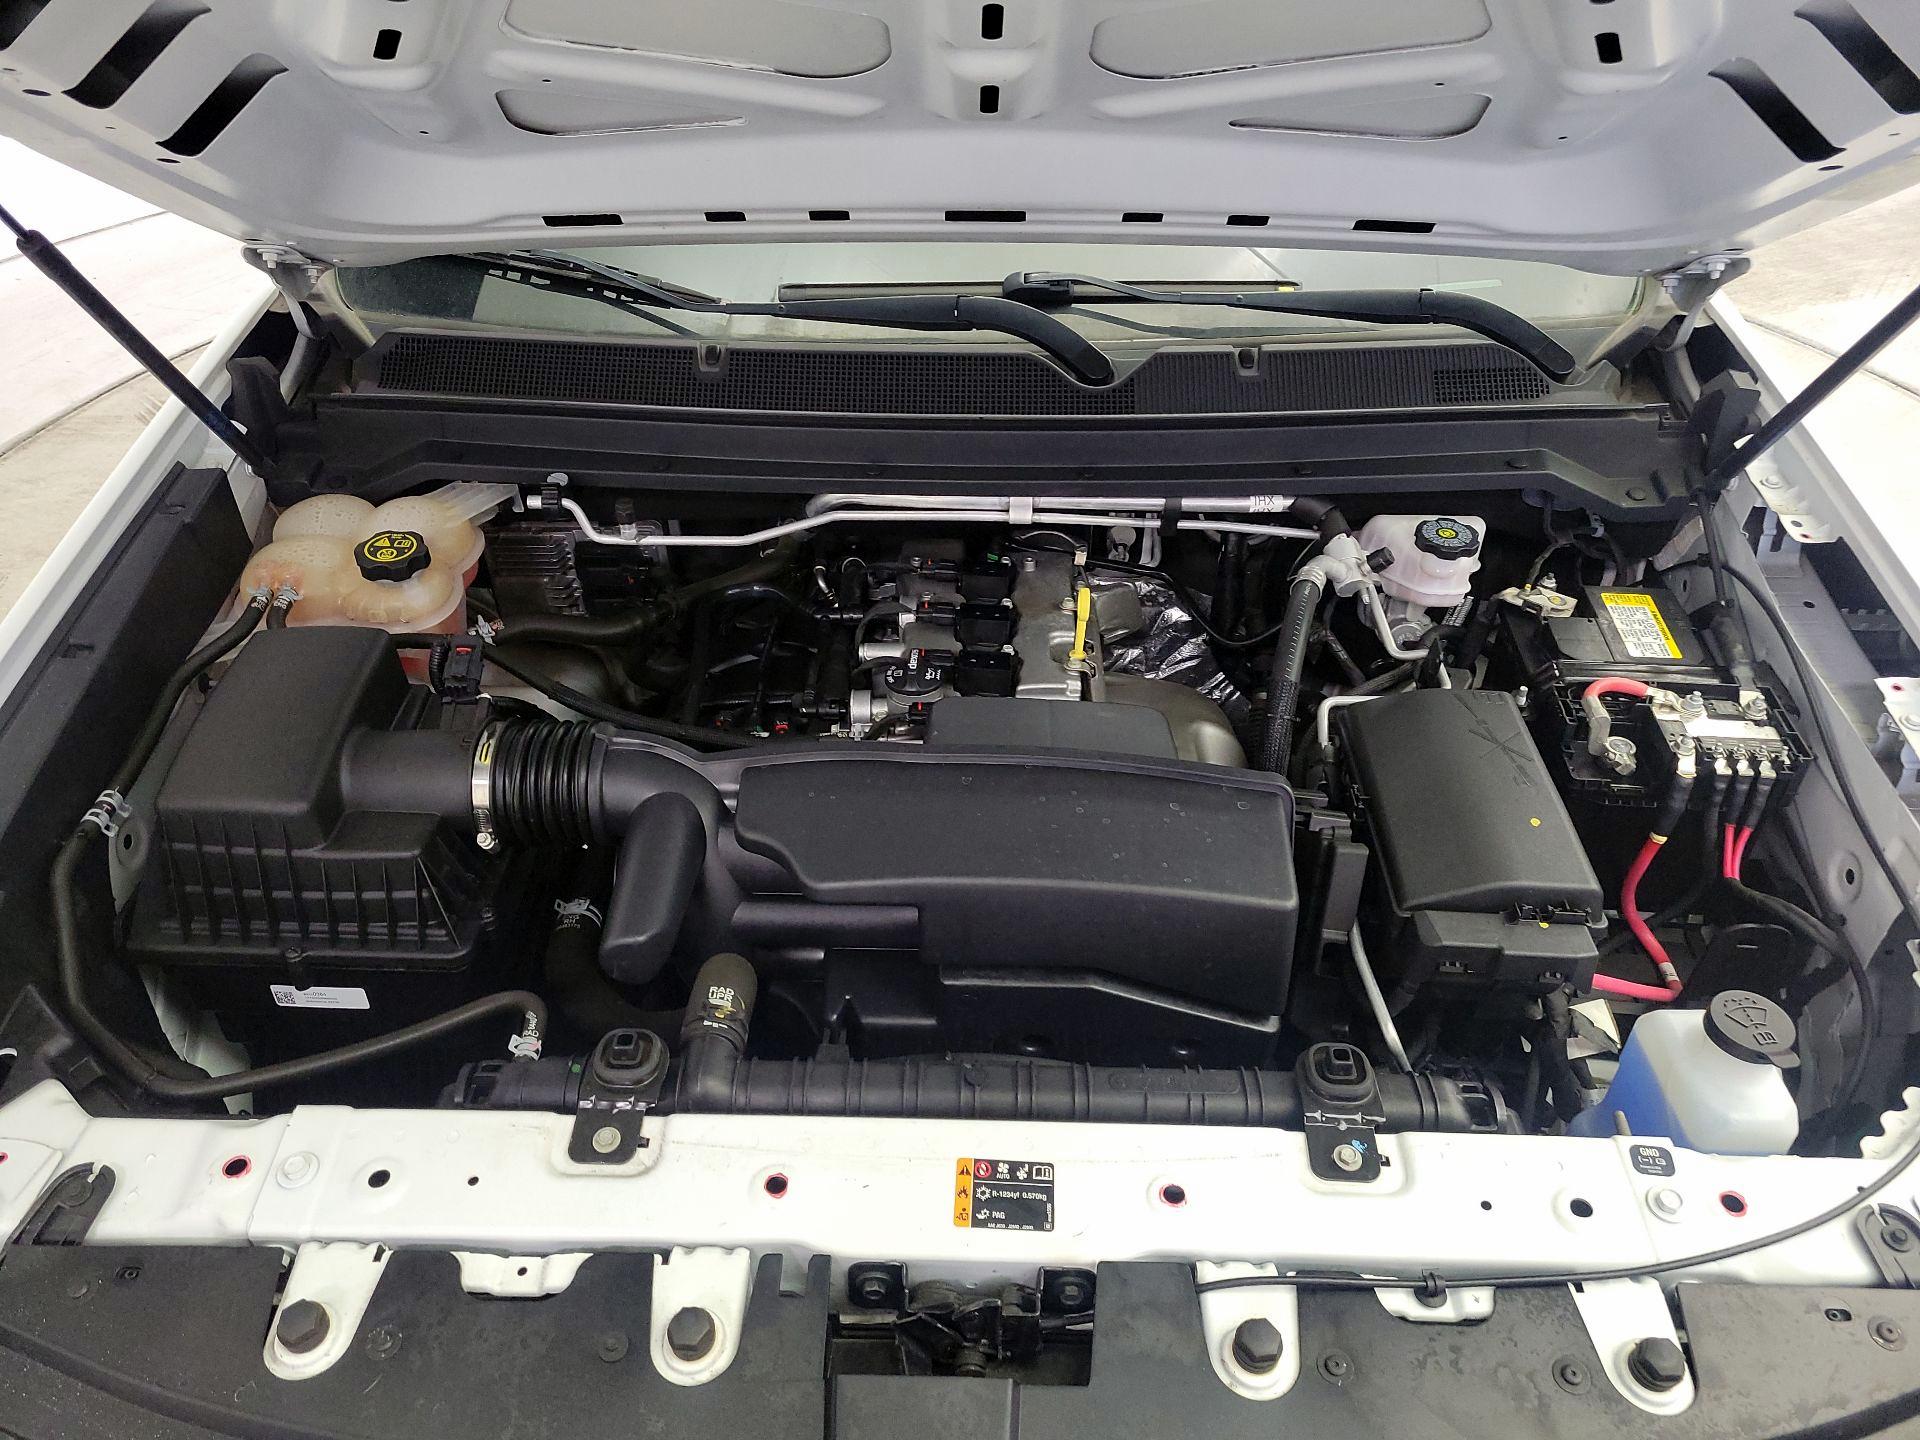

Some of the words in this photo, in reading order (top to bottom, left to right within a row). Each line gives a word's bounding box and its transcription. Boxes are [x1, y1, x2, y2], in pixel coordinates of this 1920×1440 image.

[709, 986, 735, 996] RAD
[708, 992, 733, 1003] UPR
[1639, 1147, 1660, 1157] GND
[992, 1190, 1020, 1200] R-1234yf
[1022, 1192, 1048, 1202] 0.570kg
[992, 1211, 1006, 1219] PAG
